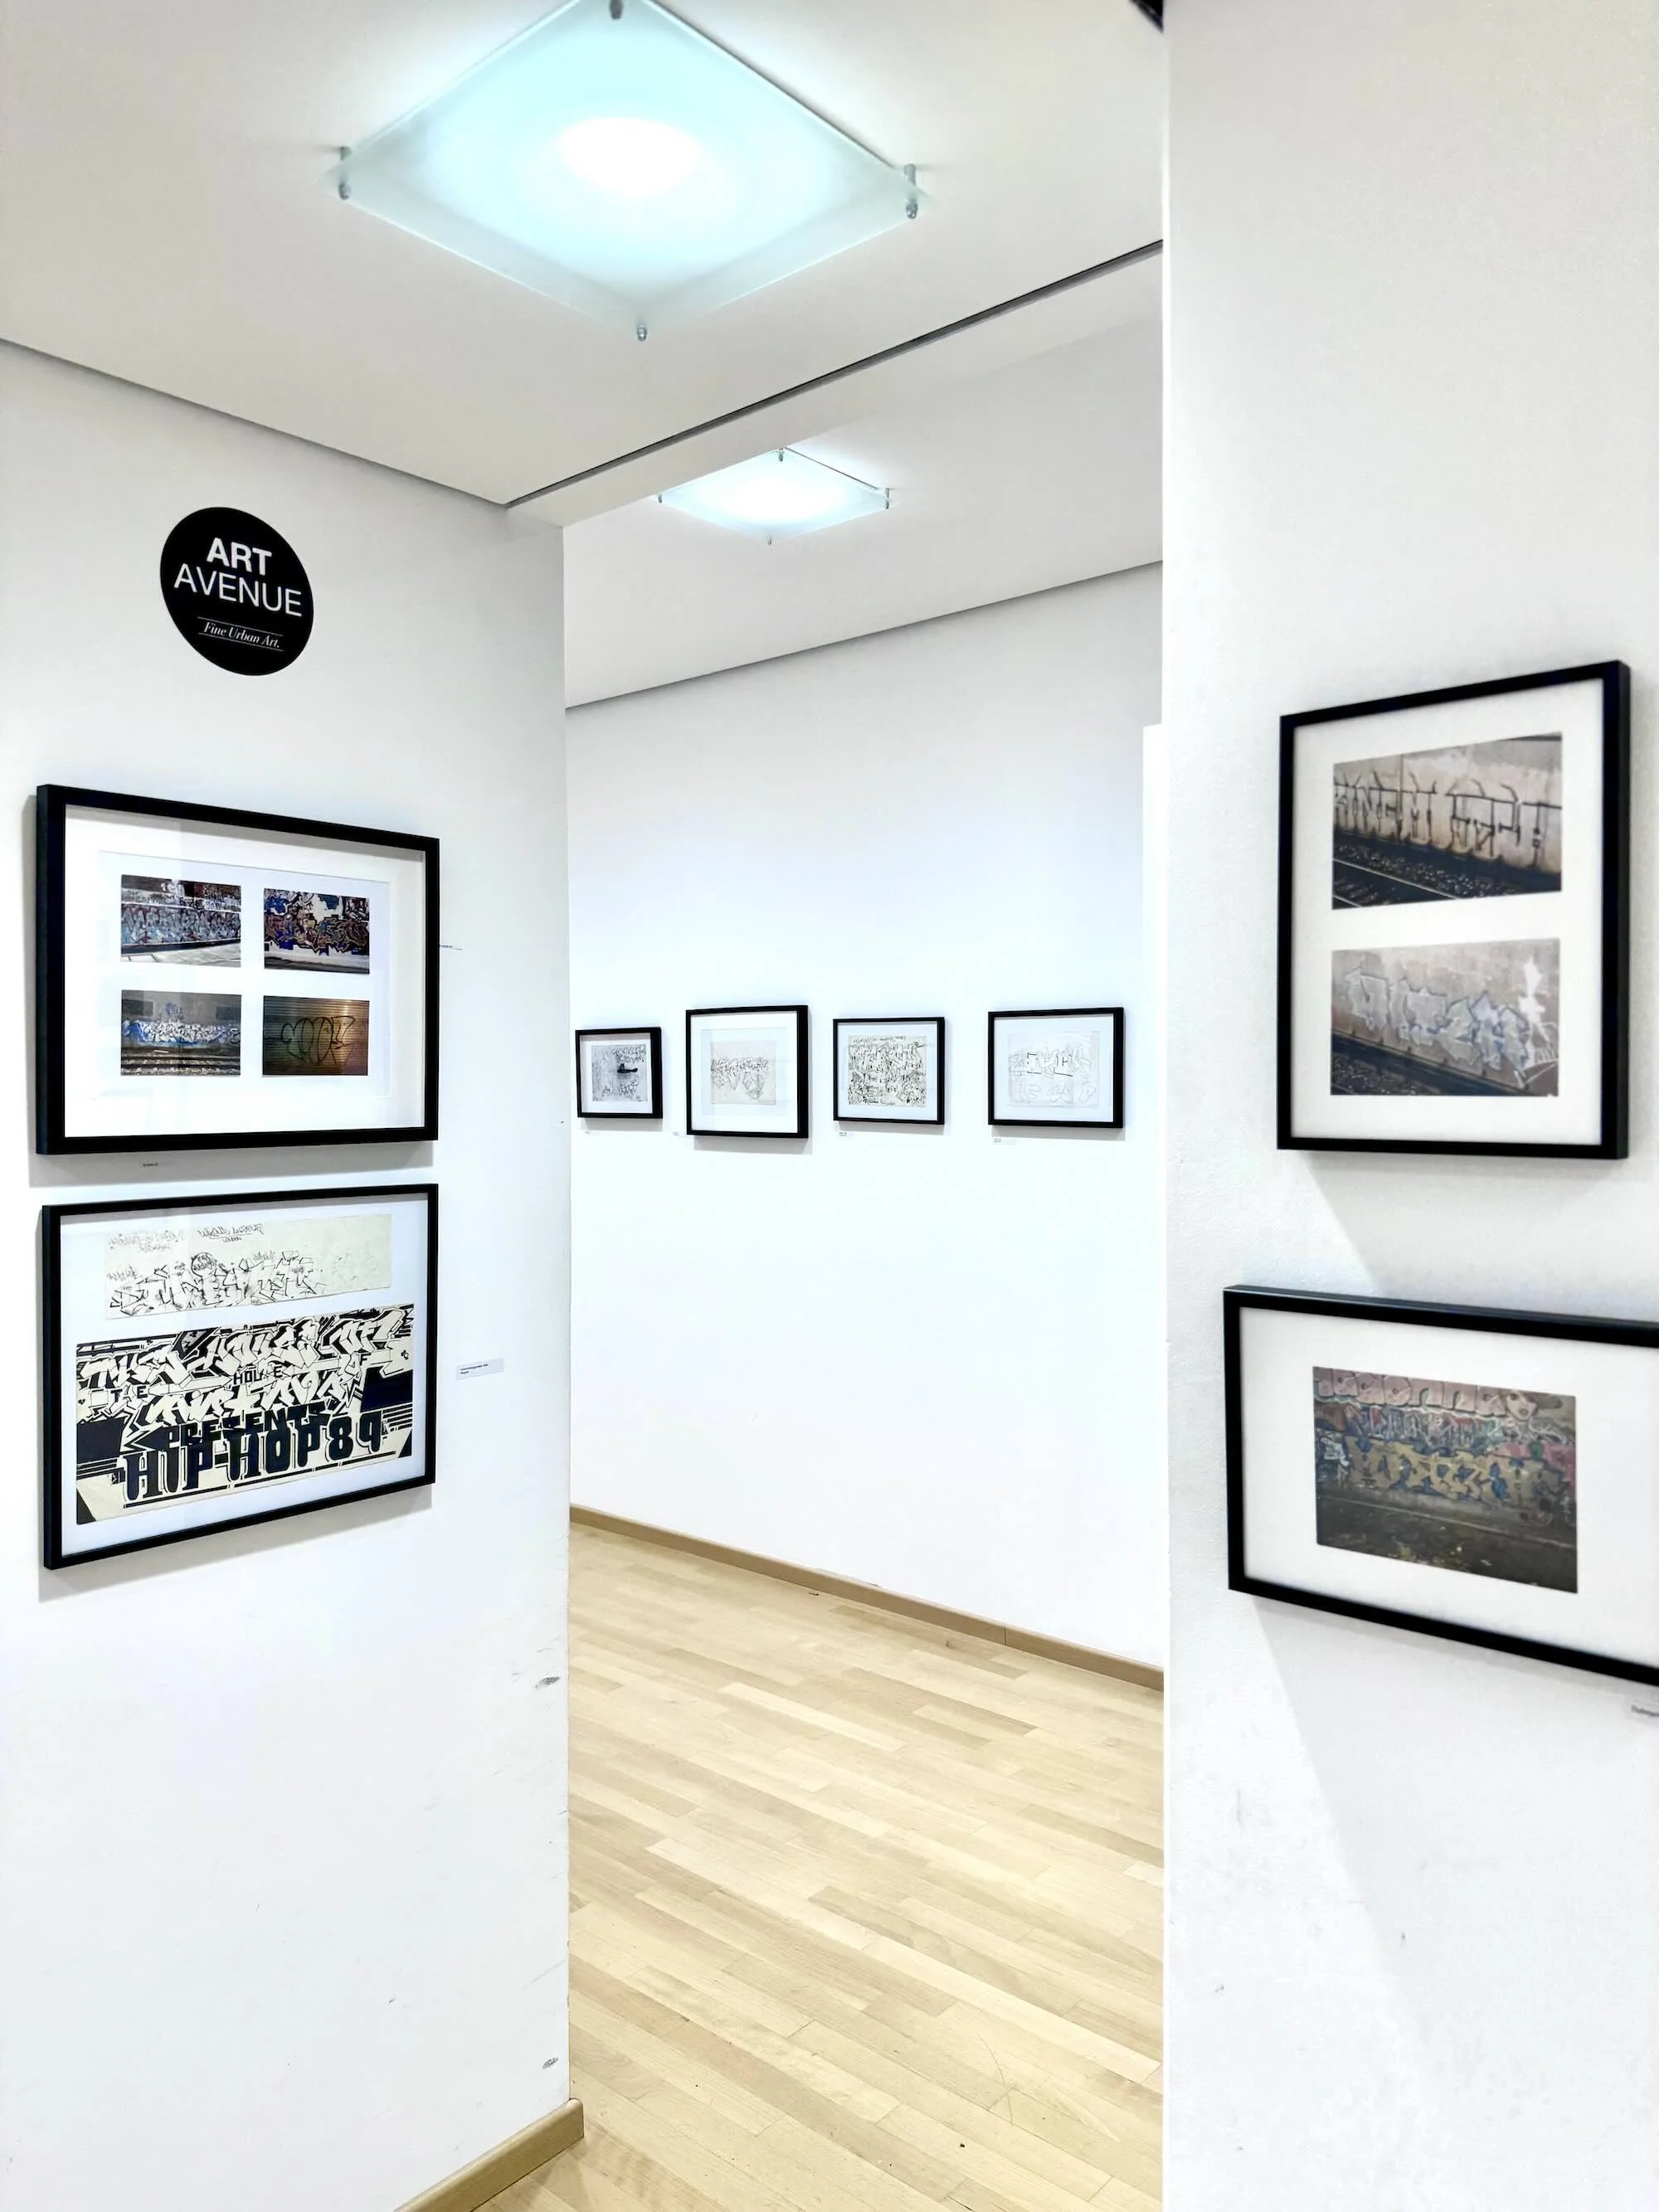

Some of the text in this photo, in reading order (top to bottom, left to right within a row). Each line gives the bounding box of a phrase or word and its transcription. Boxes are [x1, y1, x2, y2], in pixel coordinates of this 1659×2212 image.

[207, 537, 272, 576] ART
[173, 562, 302, 617] AVENUE
[203, 621, 280, 648] Fine Urban Art.
